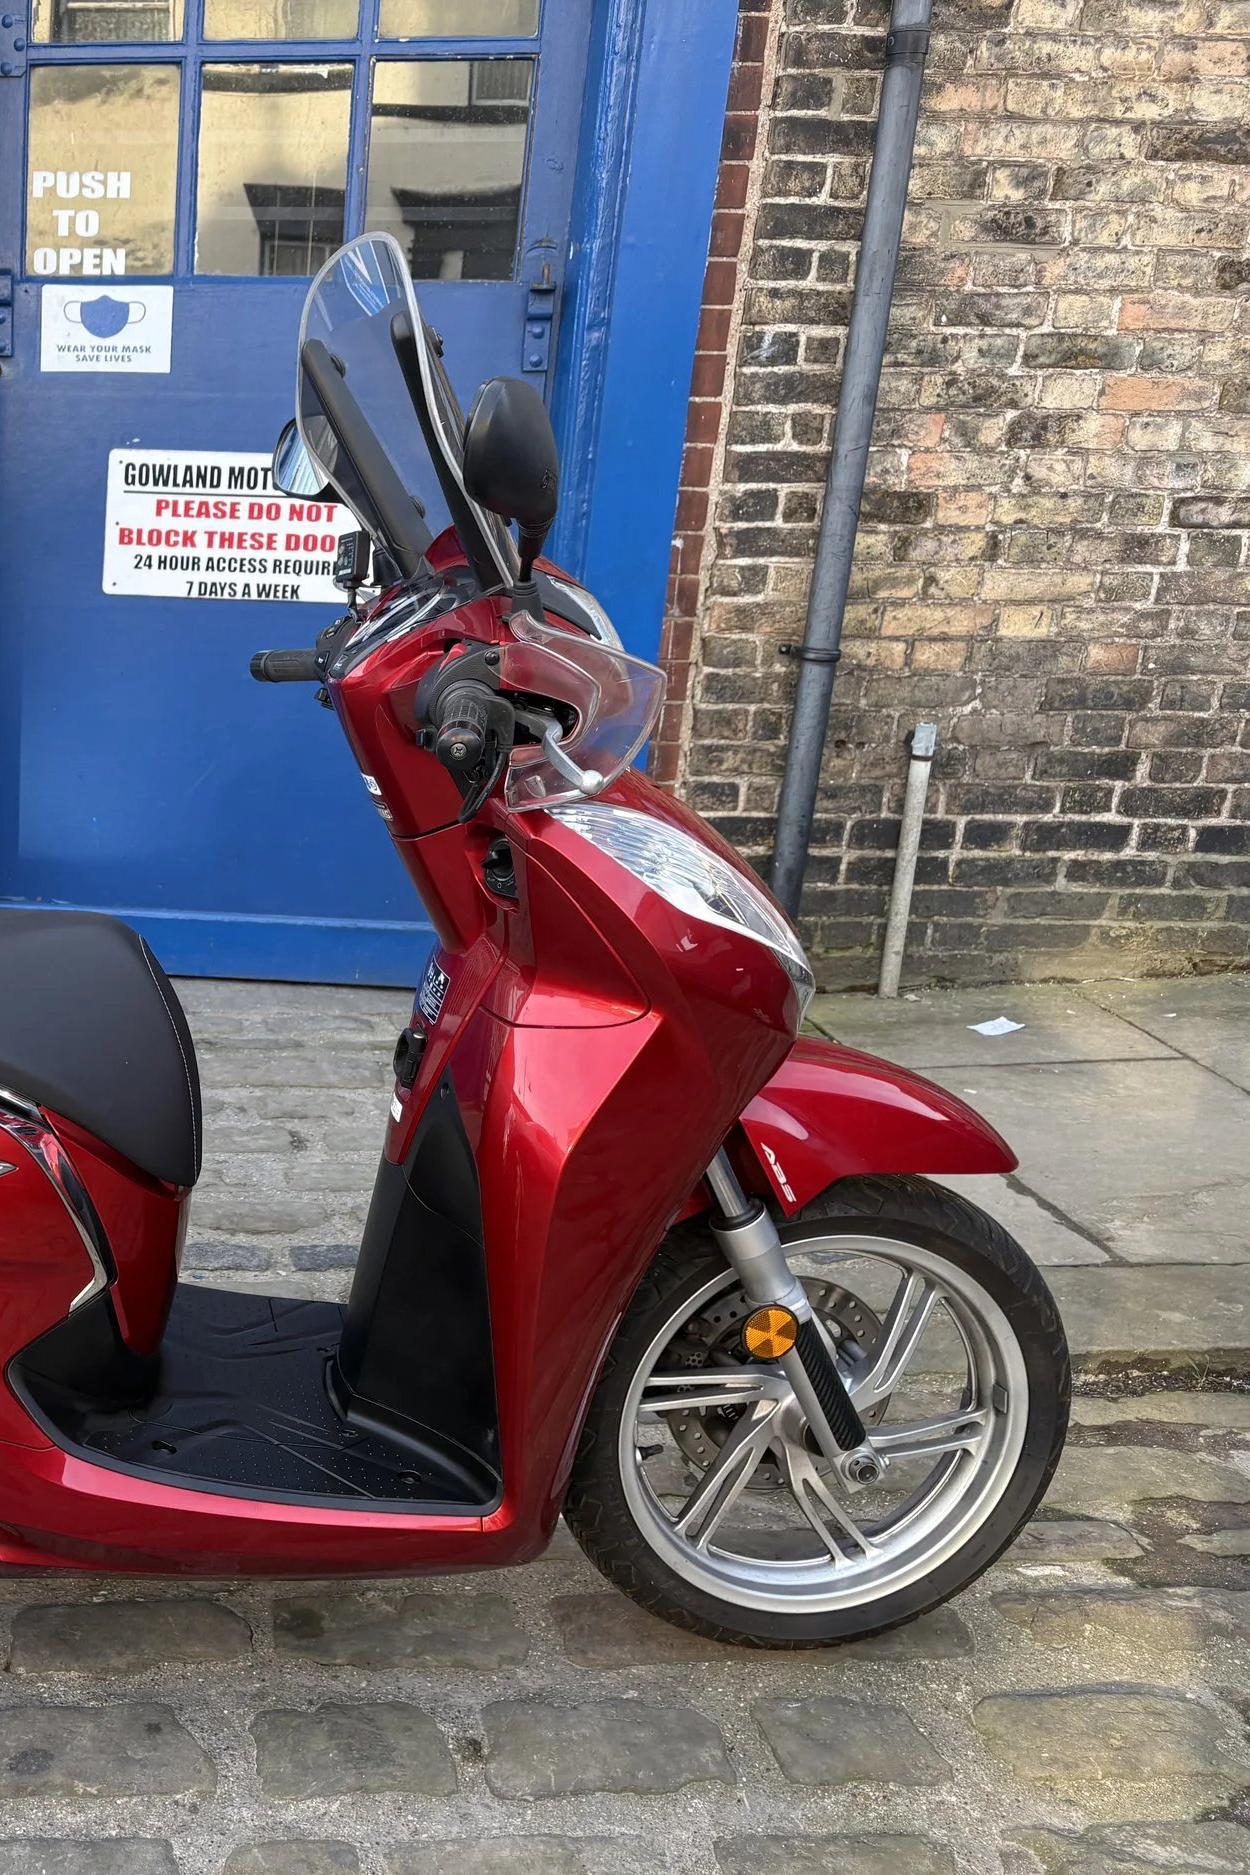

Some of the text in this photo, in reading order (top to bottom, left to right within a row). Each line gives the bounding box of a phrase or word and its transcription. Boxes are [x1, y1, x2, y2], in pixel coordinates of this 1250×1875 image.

[32, 171, 131, 198] PUSH
[53, 209, 100, 238] TO
[33, 247, 126, 276] OPEN
[57, 344, 152, 354] WEAR YOUR MASK
[75, 354, 132, 362] SAVE LIVES
[123, 462, 280, 491] GOWLAND MOT
[155, 499, 338, 522] PLEASE DO NOT
[118, 527, 197, 548] BLOCK
[204, 531, 278, 550] THESE
[284, 534, 336, 553] DOO
[134, 554, 152, 570] 24
[157, 556, 200, 571] HOUR
[205, 557, 268, 574] ACCESS
[186, 581, 301, 600] 7 DAYS A WEEK
[760, 1142, 797, 1203] ABS
